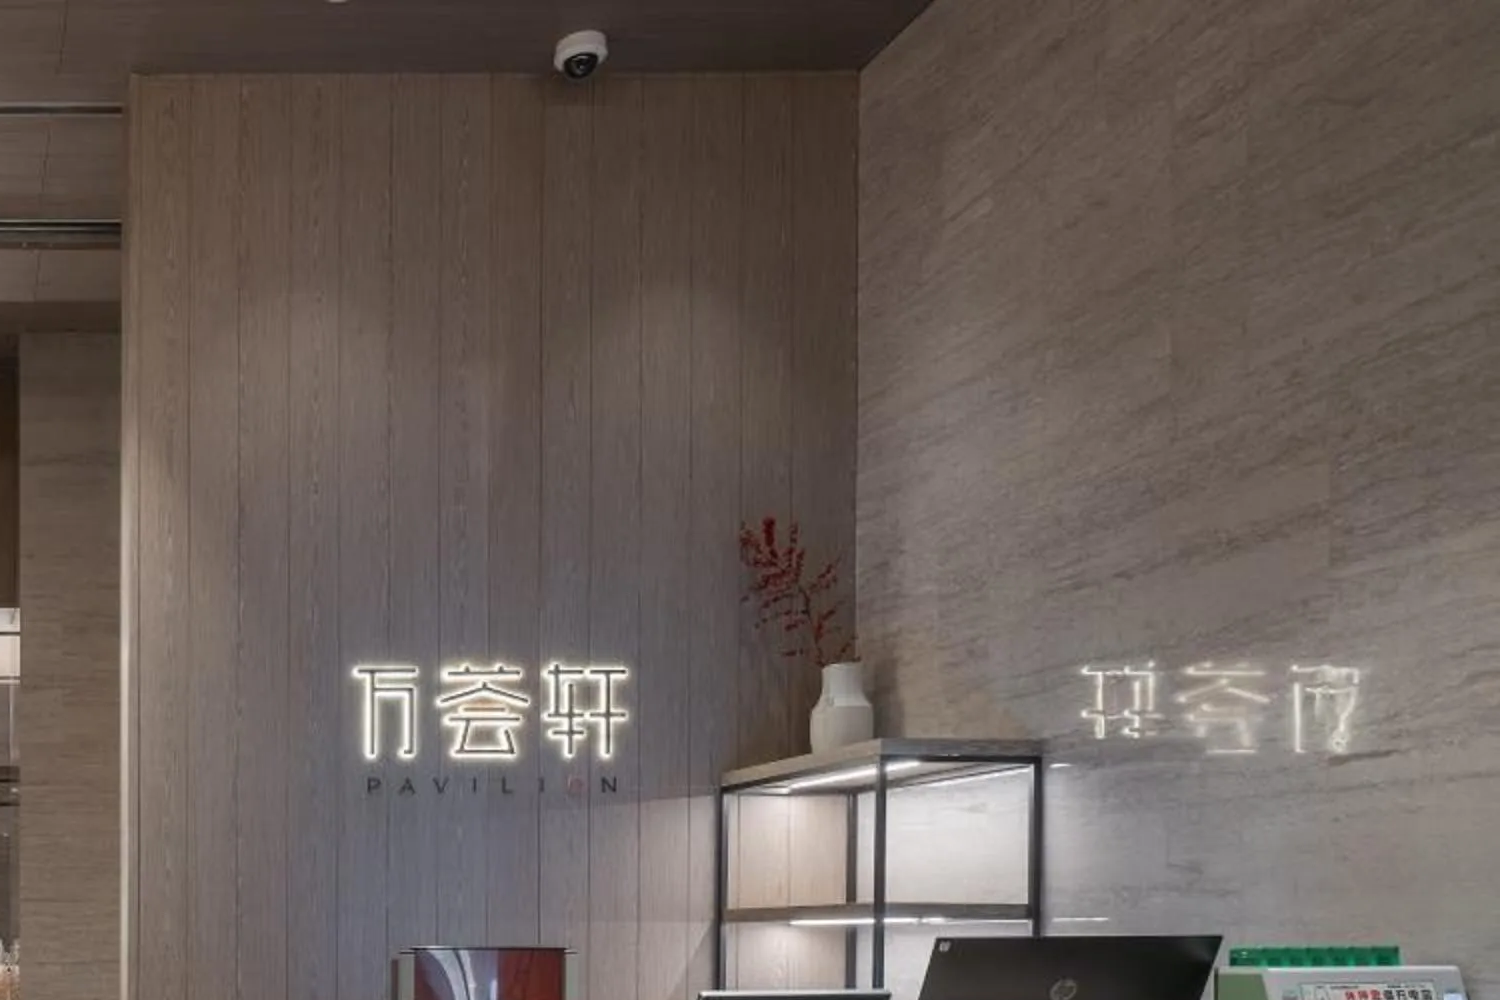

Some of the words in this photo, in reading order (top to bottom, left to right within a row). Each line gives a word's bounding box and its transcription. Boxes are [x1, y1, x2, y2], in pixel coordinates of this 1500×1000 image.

[353, 663, 629, 757] 万荟轩
[367, 777, 617, 794] PAVILION
